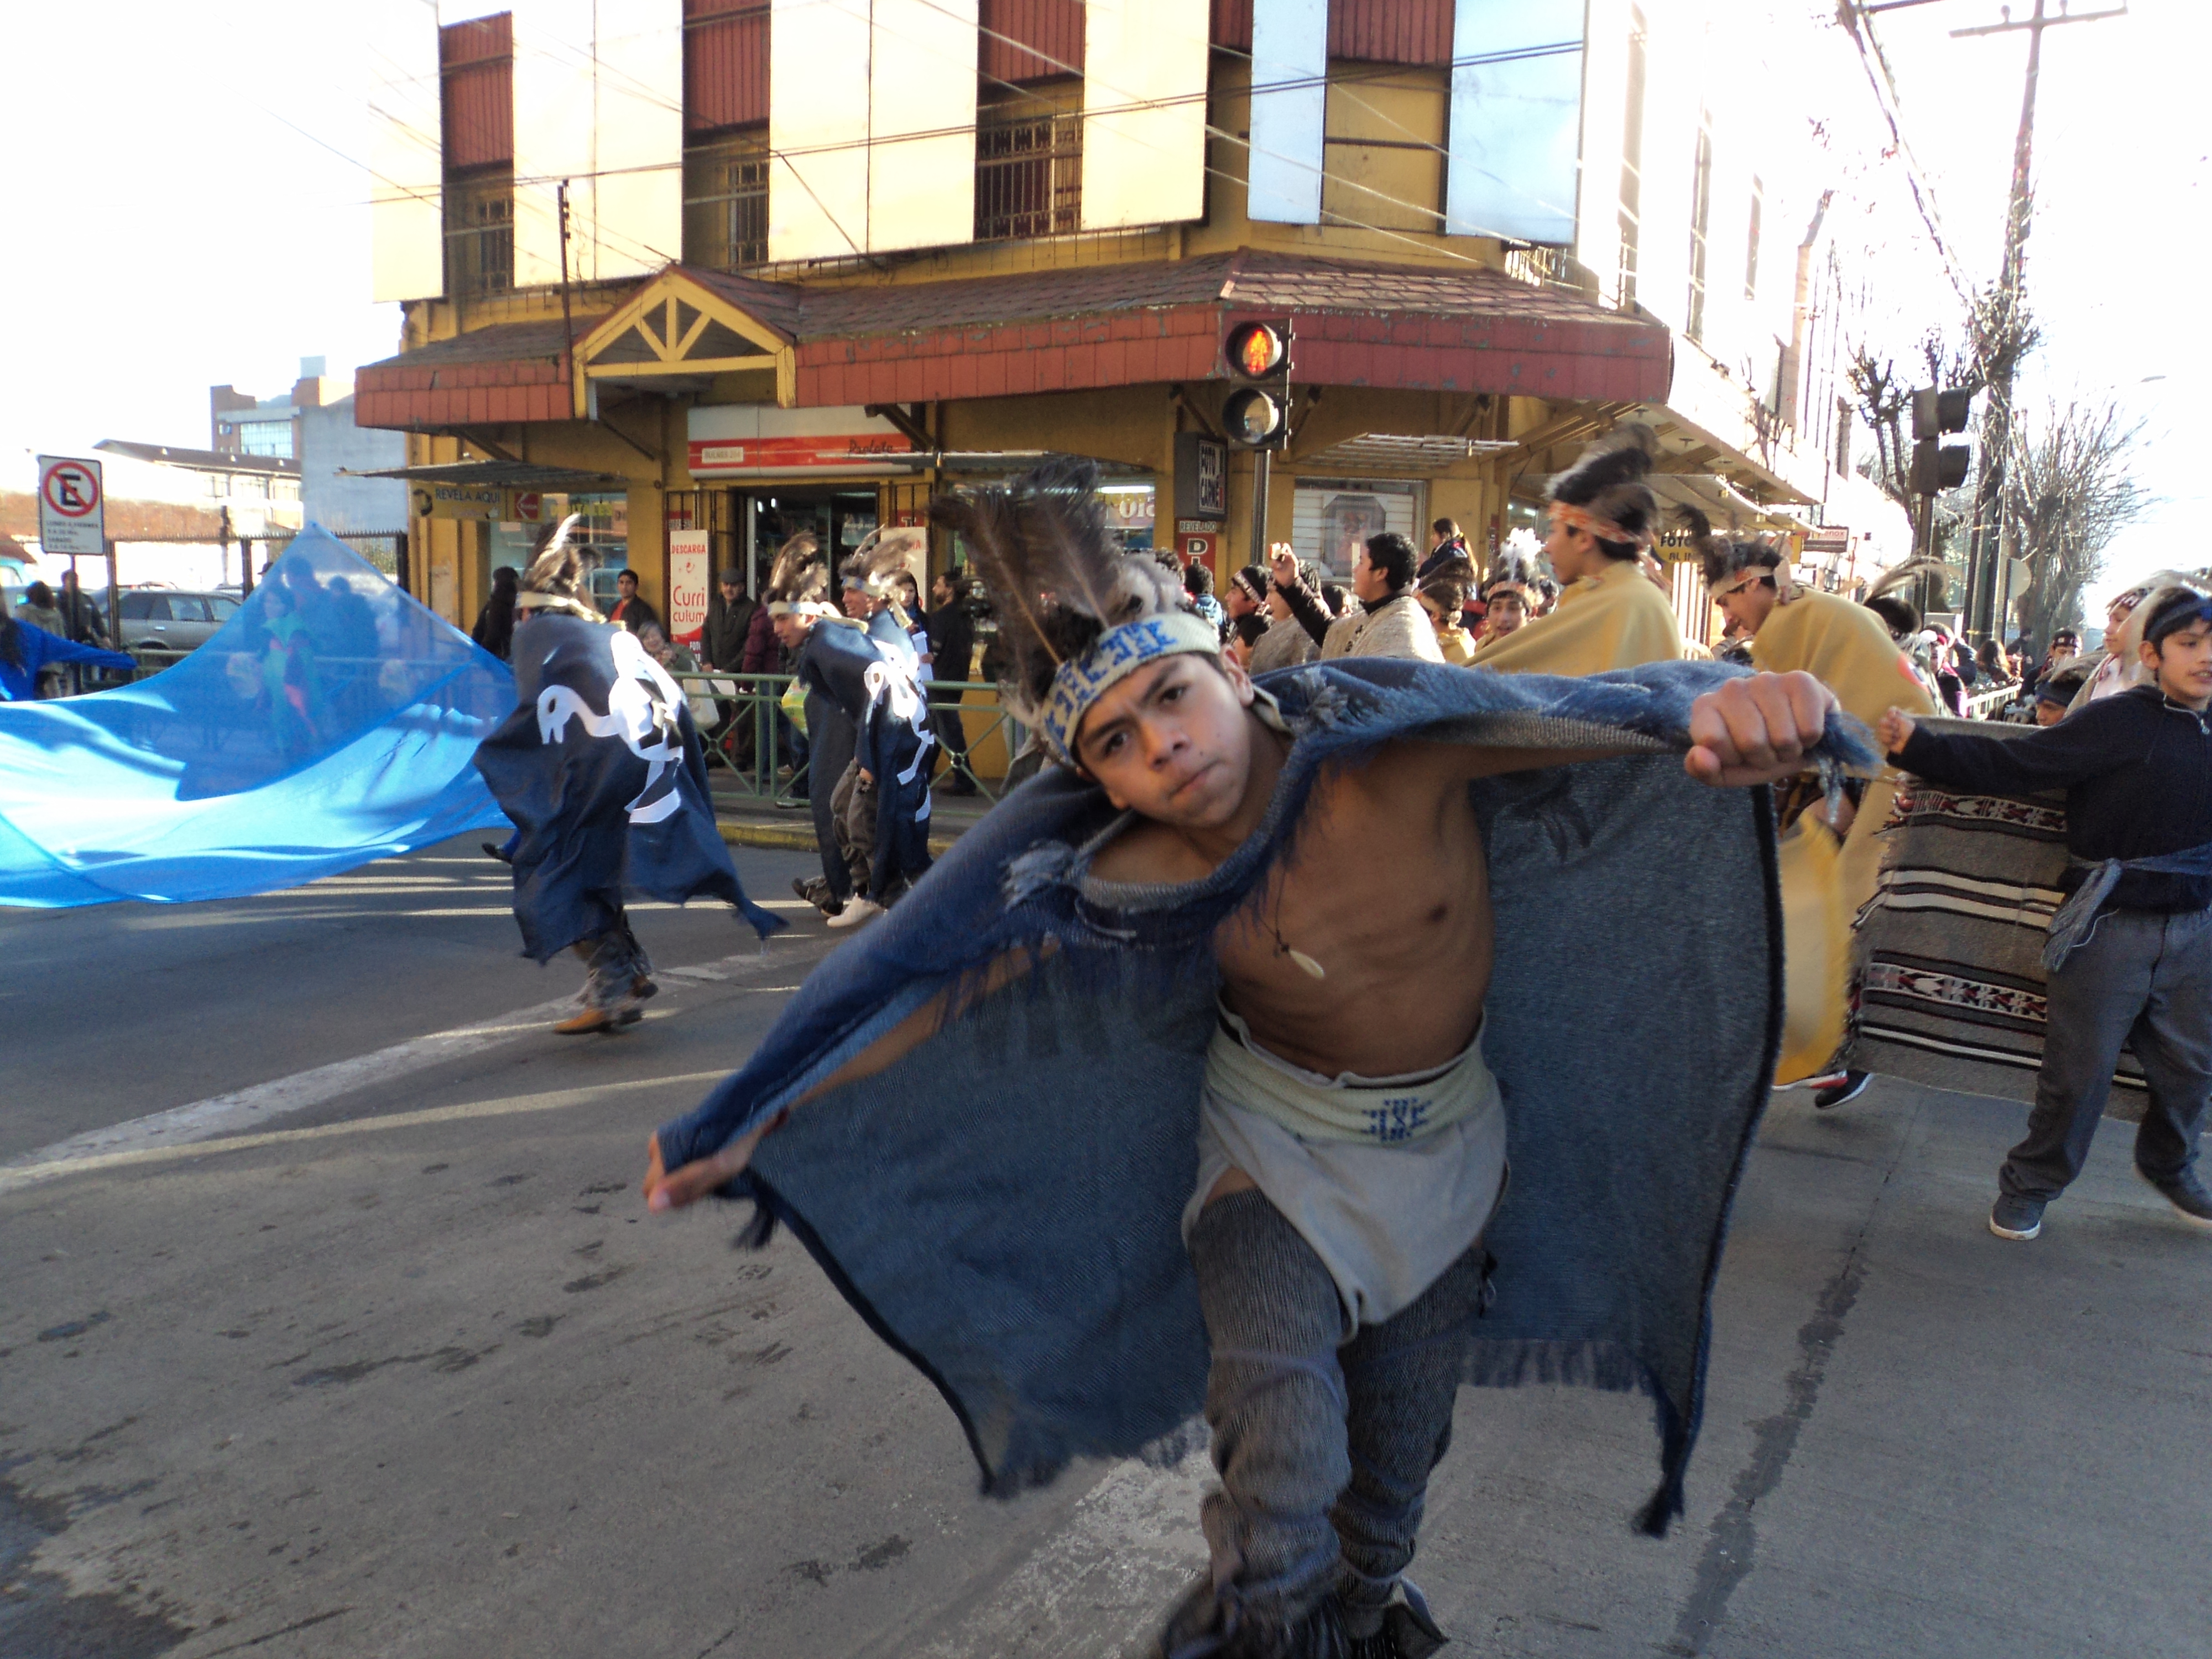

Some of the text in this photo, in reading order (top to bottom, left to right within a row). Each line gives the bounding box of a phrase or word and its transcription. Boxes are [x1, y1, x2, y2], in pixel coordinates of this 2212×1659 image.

[435, 488, 473, 502] REVELA
[1179, 520, 1217, 533] REVELADO
[671, 544, 706, 554] DESCARGA
[673, 585, 705, 607] Curri
[673, 609, 705, 622] culum
